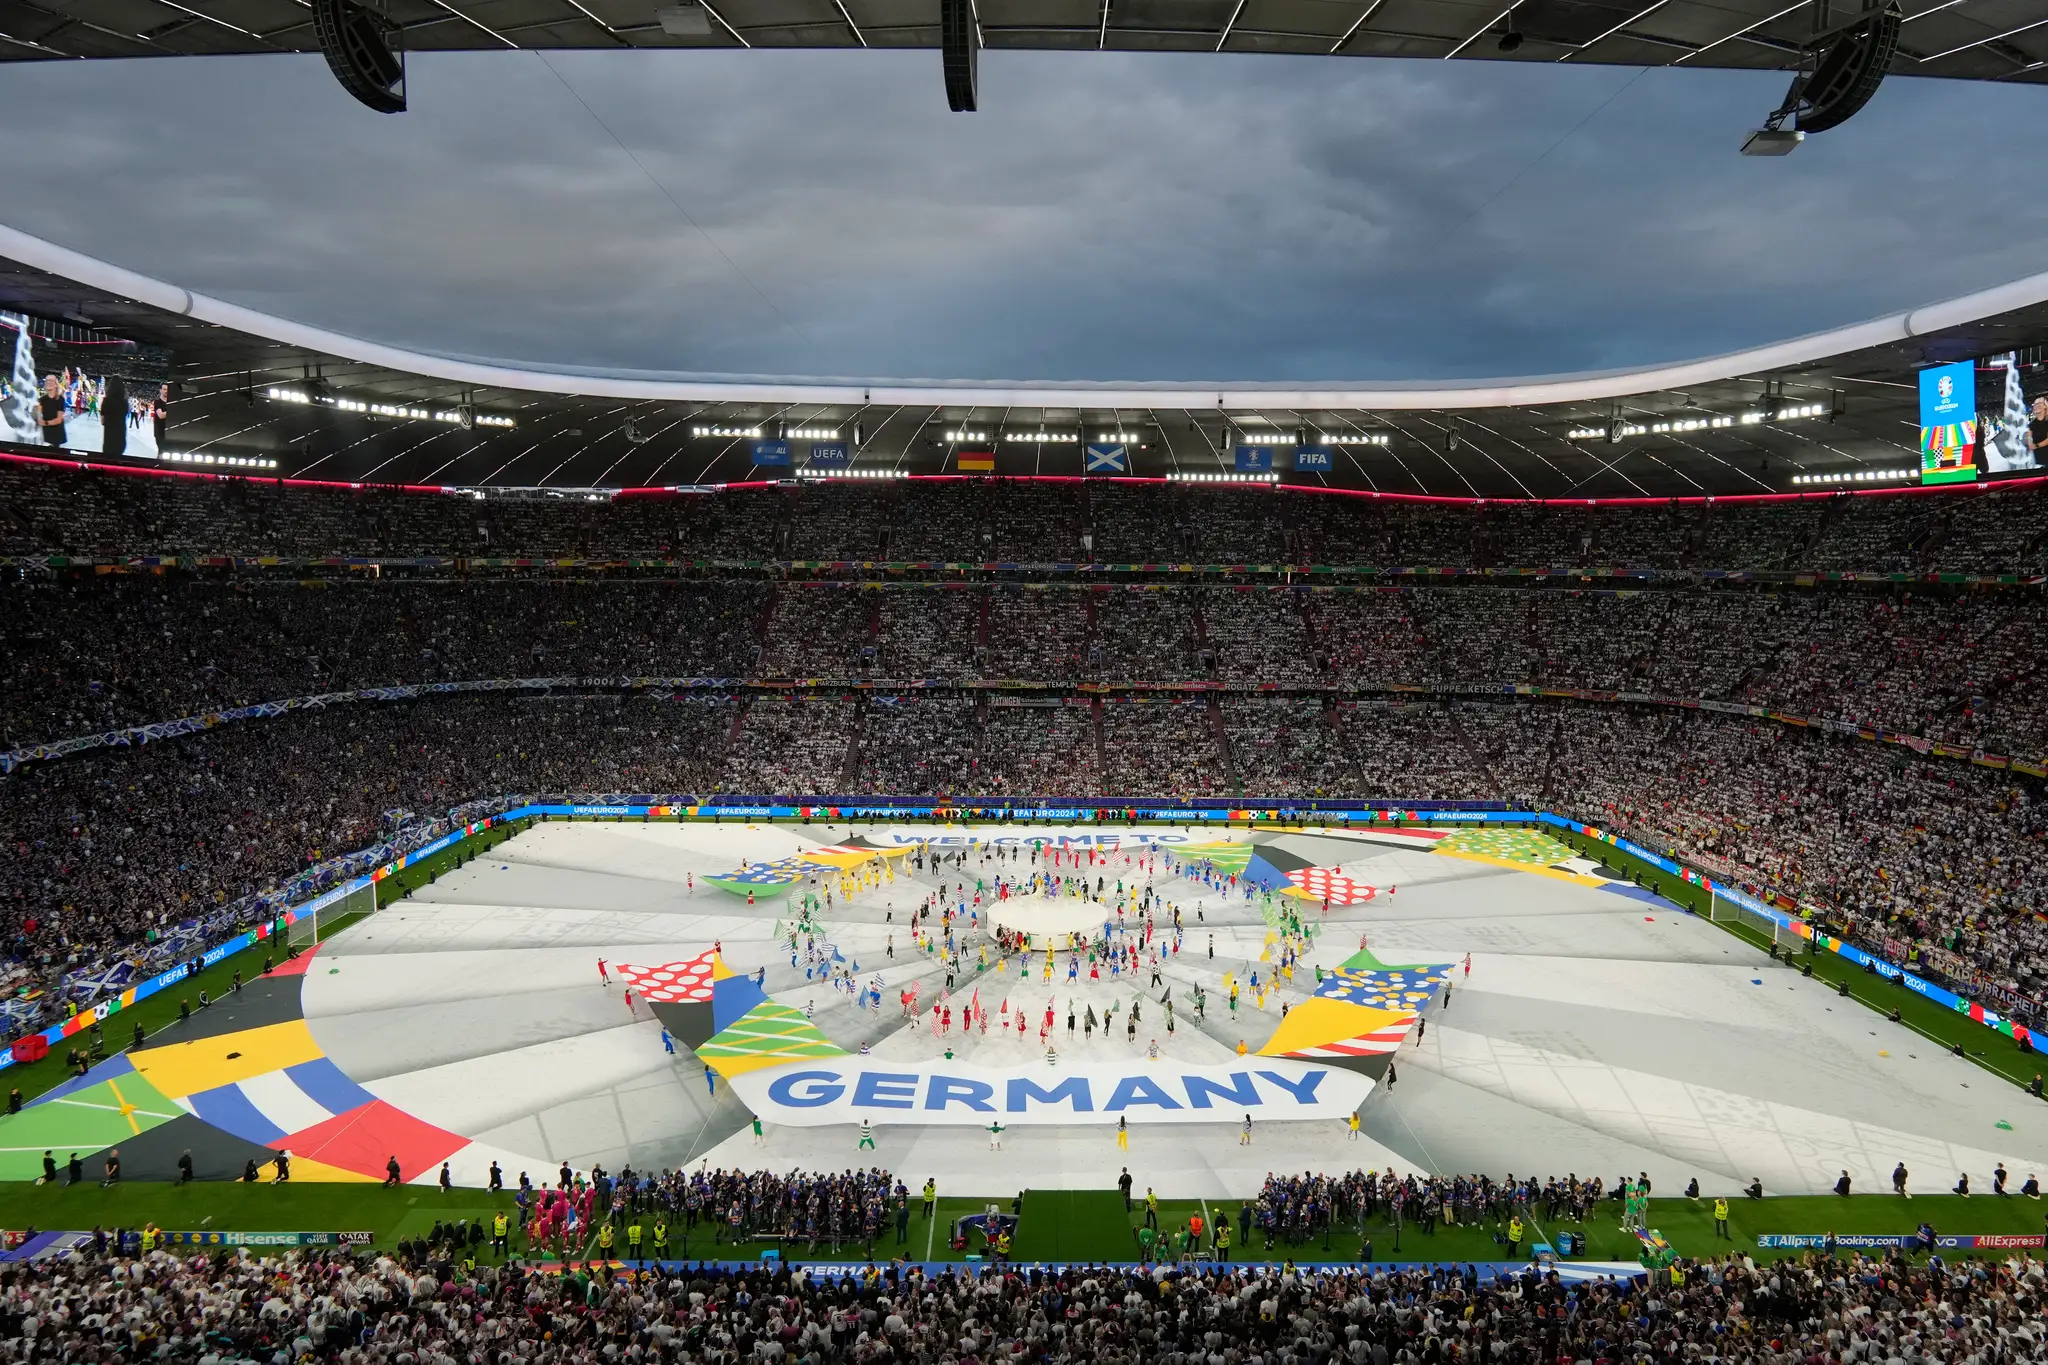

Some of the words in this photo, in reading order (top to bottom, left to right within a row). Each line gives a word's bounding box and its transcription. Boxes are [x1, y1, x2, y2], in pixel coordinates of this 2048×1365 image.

[813, 449, 844, 459] UEFA
[1299, 453, 1327, 464] FIFA
[573, 806, 629, 814] UEFAEURO2024
[893, 834, 1120, 847] WELCOME
[1129, 834, 1188, 843] TO
[768, 1070, 1328, 1112] GERMANY
[226, 1233, 297, 1245] Hisense
[339, 1233, 370, 1241] QATAR
[1977, 1235, 2041, 1248] AliExpress
